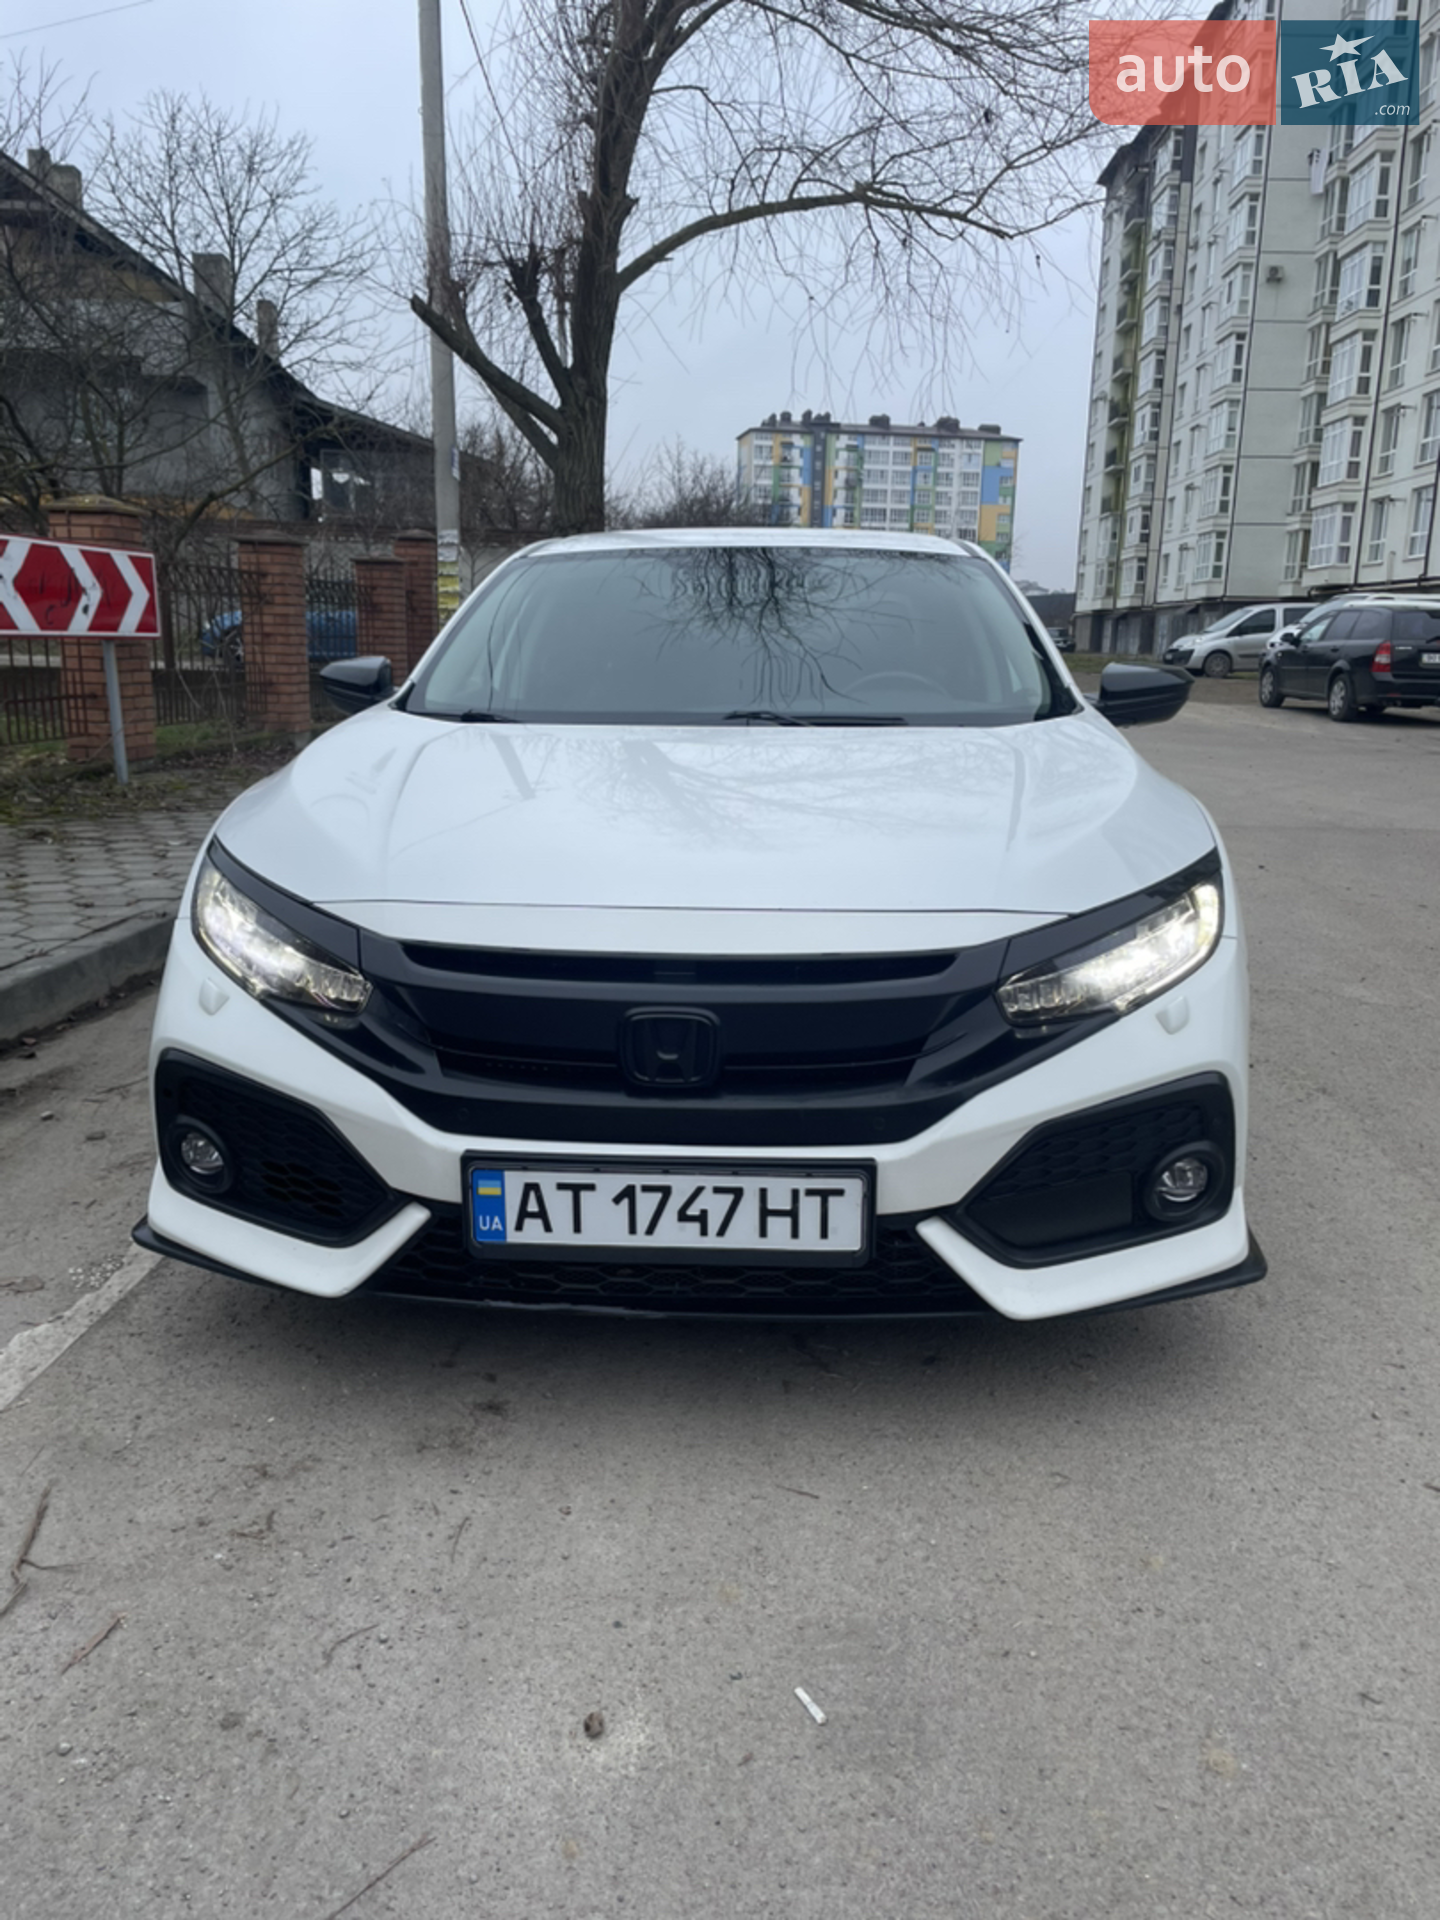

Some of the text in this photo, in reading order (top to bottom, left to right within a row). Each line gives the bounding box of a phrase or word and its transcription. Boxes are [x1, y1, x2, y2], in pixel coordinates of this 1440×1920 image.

[478, 1215, 504, 1232] UA
[513, 1182, 846, 1240] AT 1747 HT
